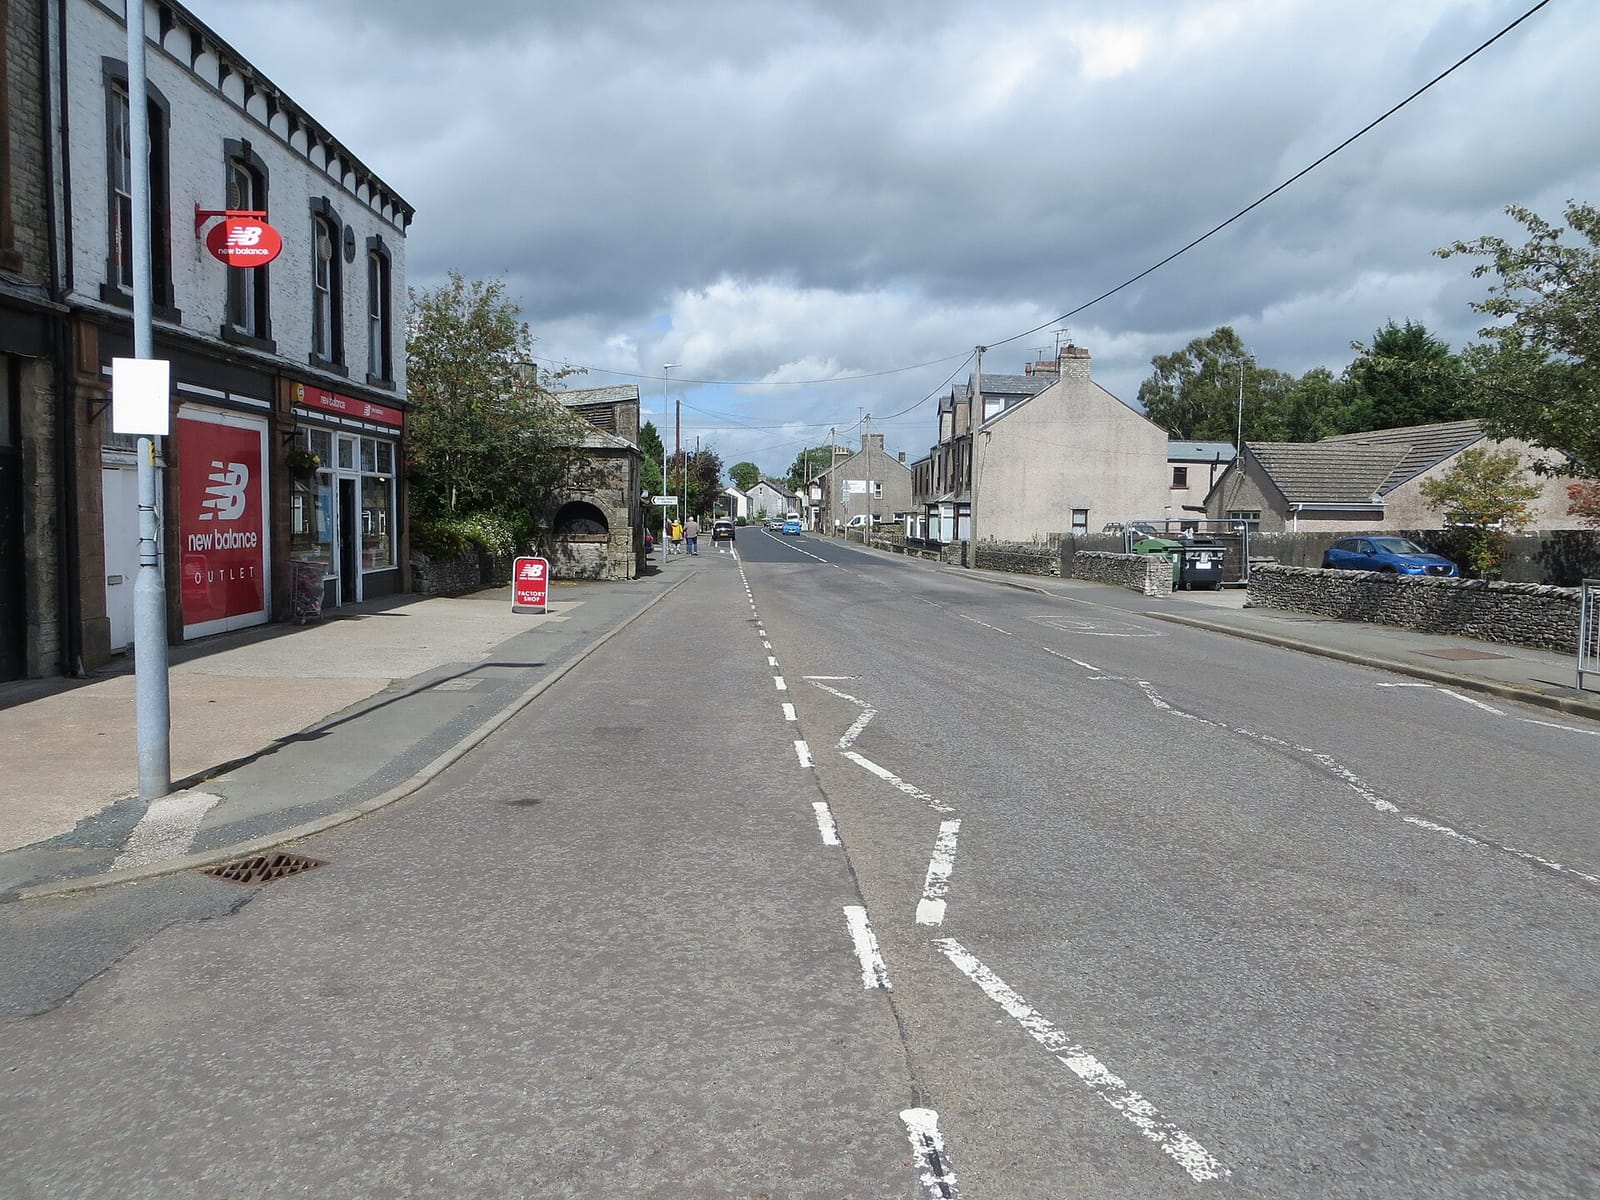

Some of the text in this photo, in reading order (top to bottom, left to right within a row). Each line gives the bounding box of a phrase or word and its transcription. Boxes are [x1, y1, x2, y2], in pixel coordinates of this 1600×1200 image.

[198, 460, 250, 521] NB
[188, 528, 257, 552] new balance
[194, 566, 255, 585] OUTLET
